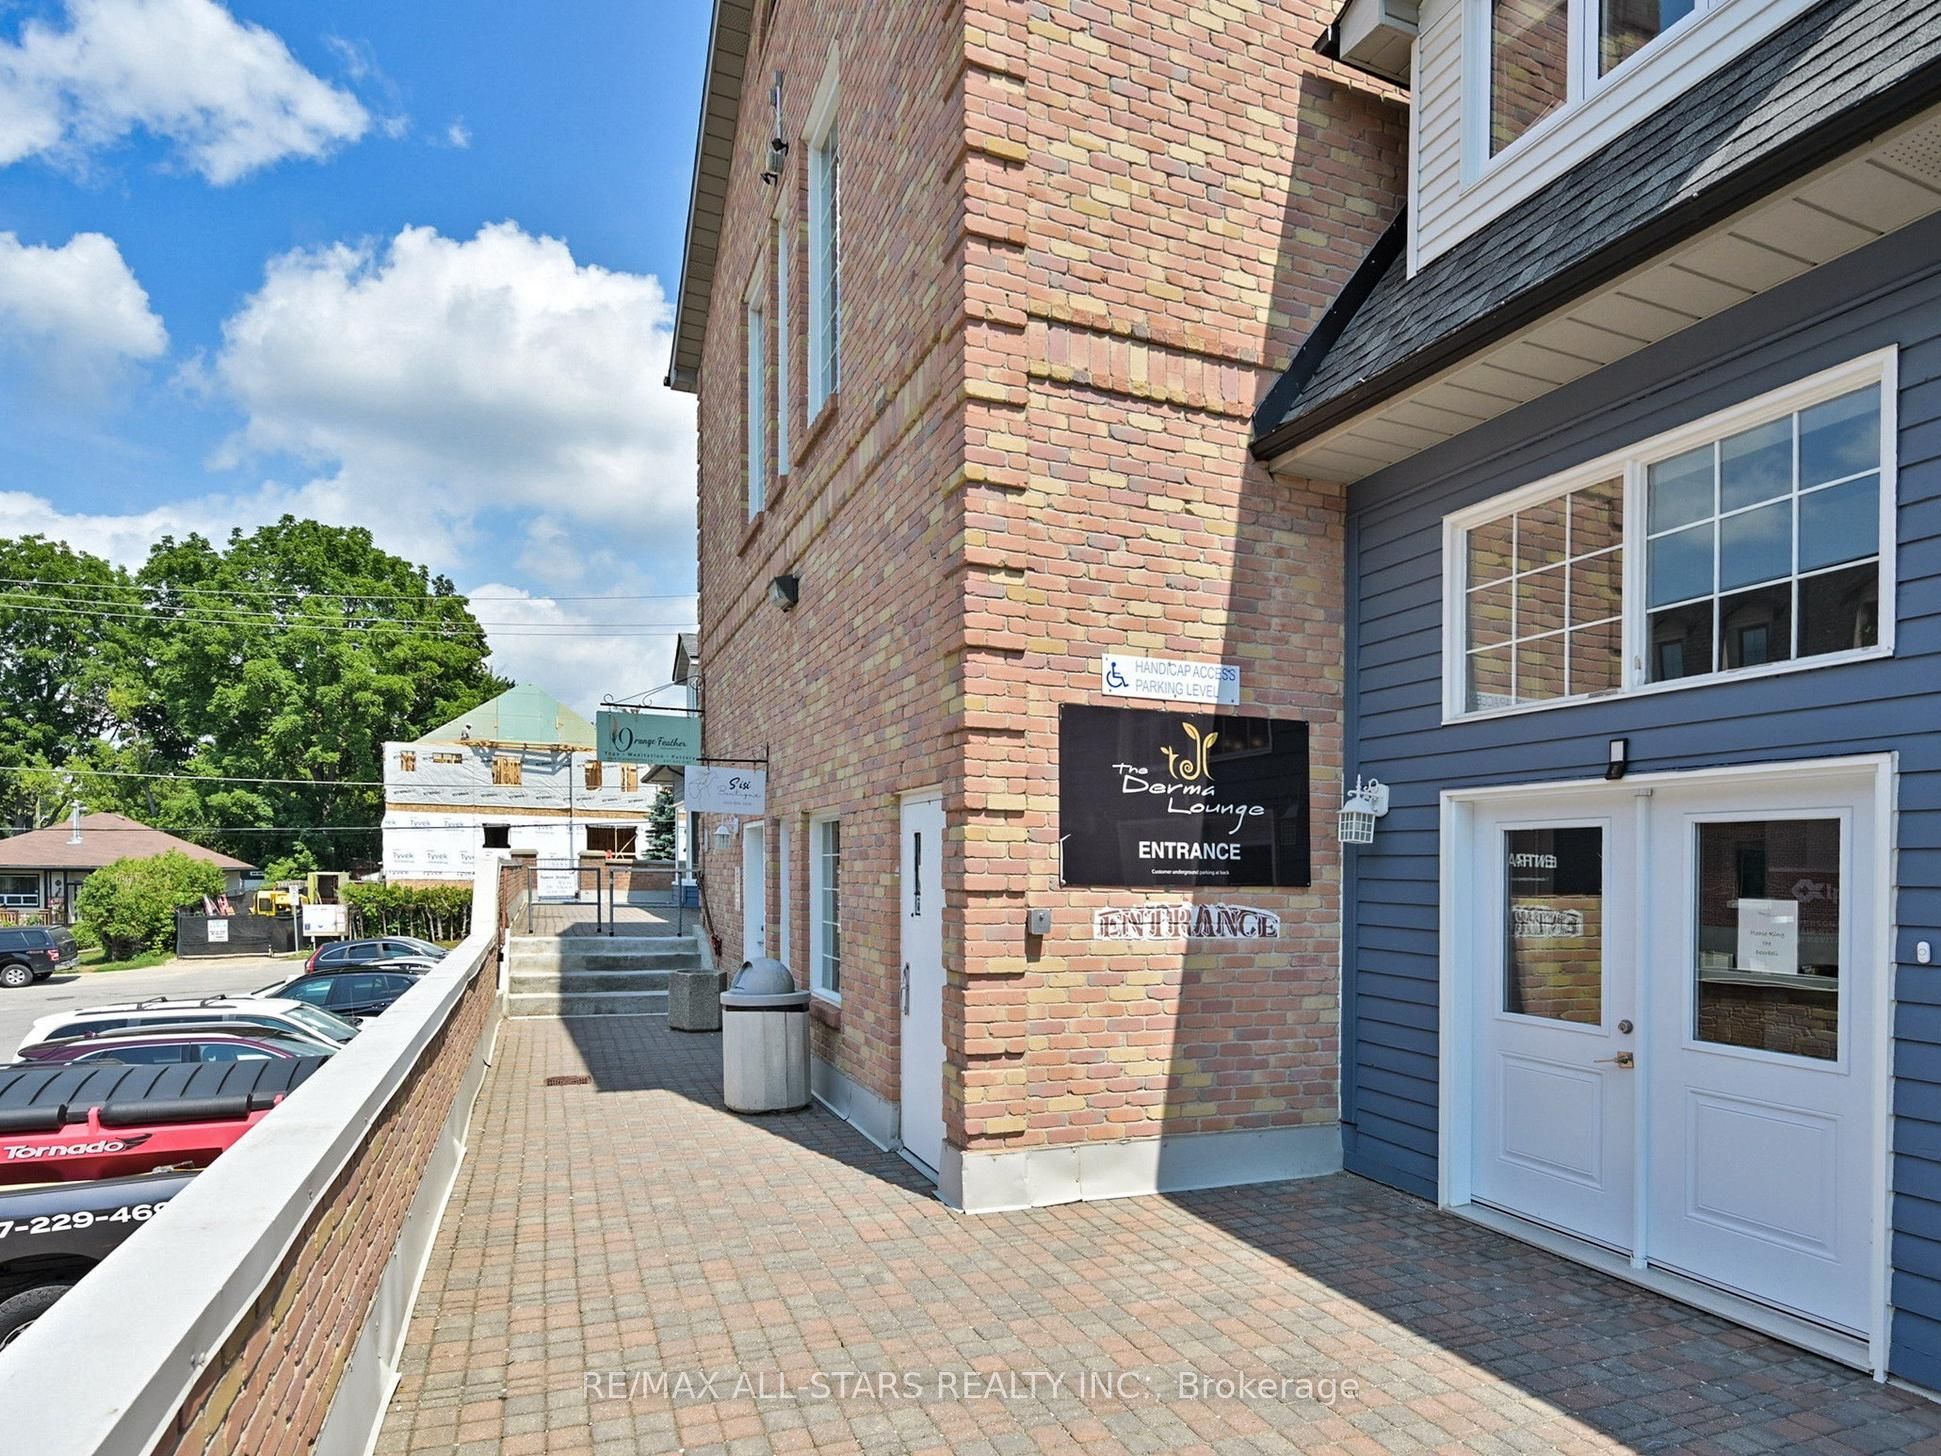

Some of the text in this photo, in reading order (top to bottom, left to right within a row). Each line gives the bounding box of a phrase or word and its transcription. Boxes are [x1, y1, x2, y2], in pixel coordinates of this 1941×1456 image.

[1135, 661, 1236, 681] HANDICAP ACCESS
[1135, 680, 1219, 698] PARKING LEVEL
[612, 727, 687, 752] Orange Feather
[1112, 762, 1149, 775] The
[729, 776, 751, 790] Sisi
[1122, 775, 1215, 797] Derma
[1167, 797, 1265, 835] Lounge
[1138, 841, 1241, 860] ENTRANCE
[1100, 904, 1278, 938] ENTRANCE
[4, 1140, 124, 1160] Tornado
